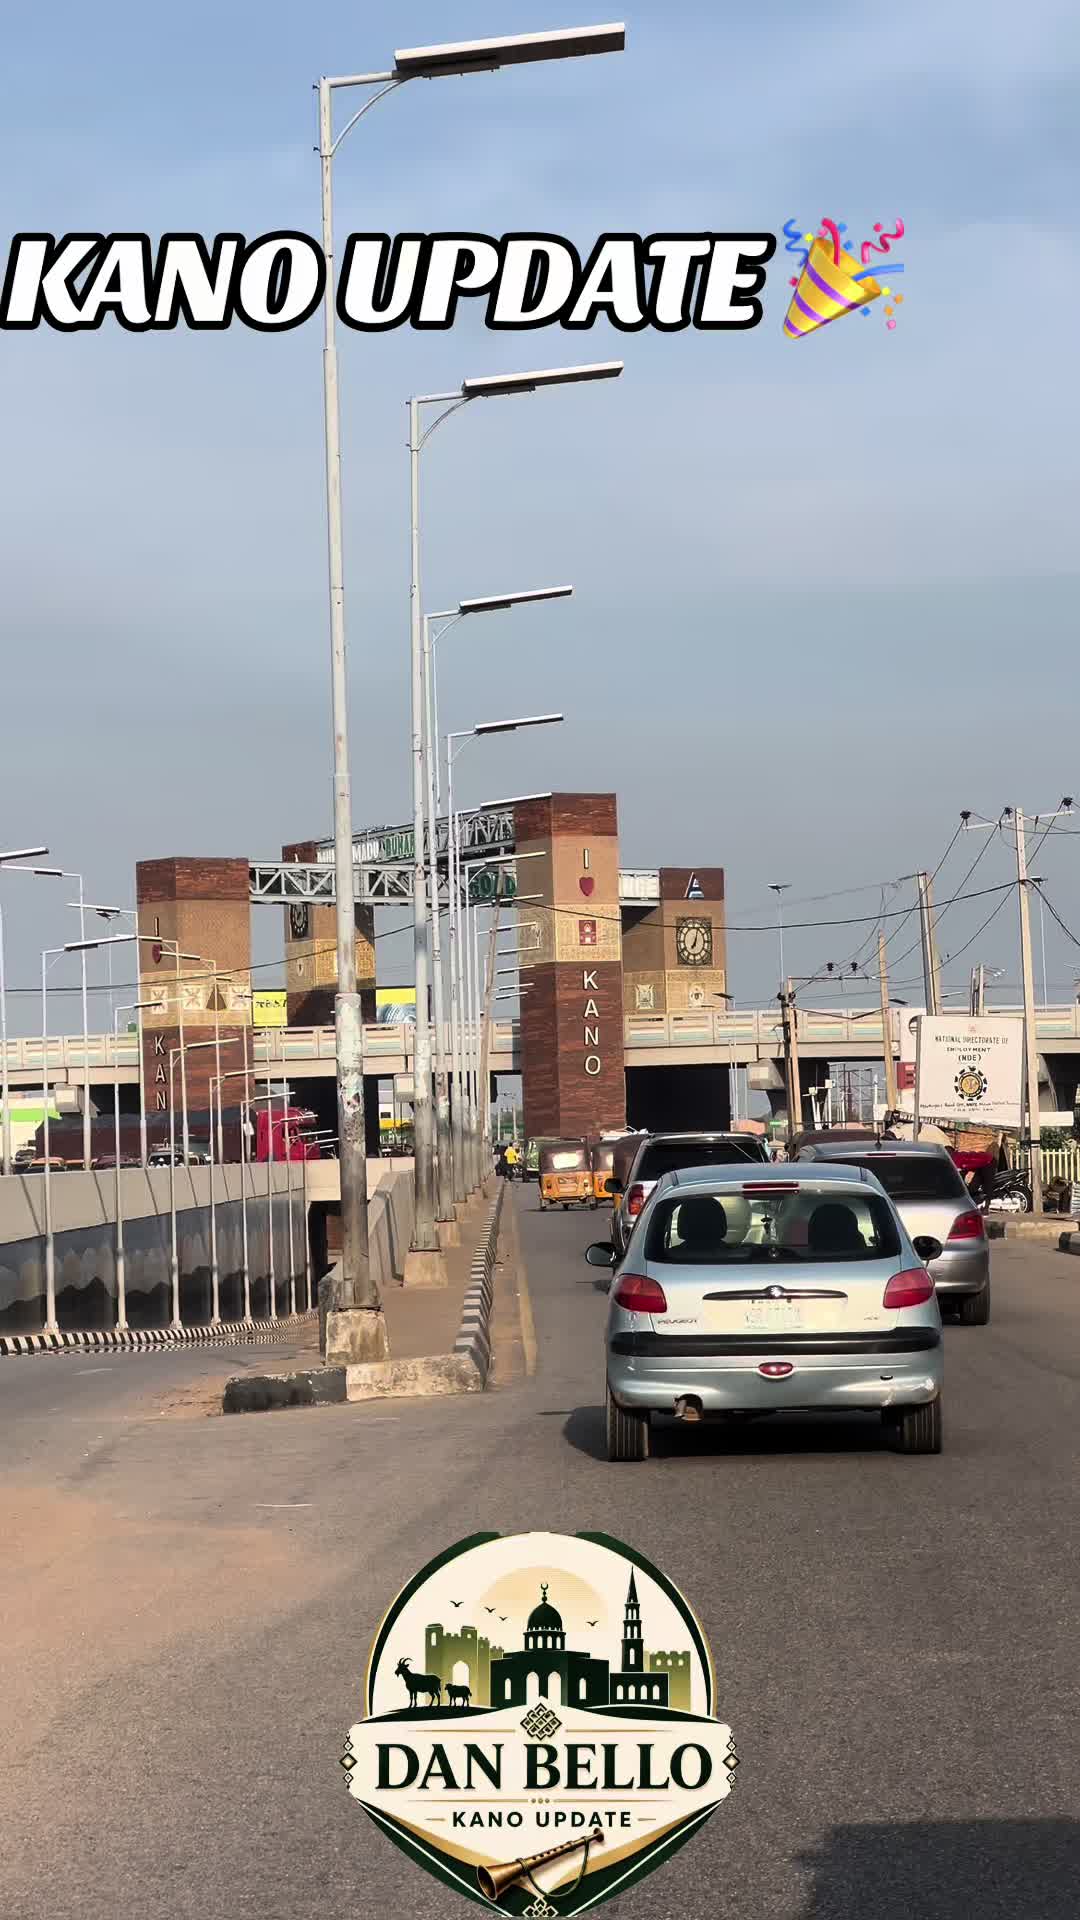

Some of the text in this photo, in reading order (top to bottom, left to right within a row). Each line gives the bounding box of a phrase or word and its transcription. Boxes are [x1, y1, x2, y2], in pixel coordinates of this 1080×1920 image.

[583, 969, 602, 1075] KANO
[958, 1053, 982, 1062] (NDE)
[154, 1034, 167, 1111] KAN
